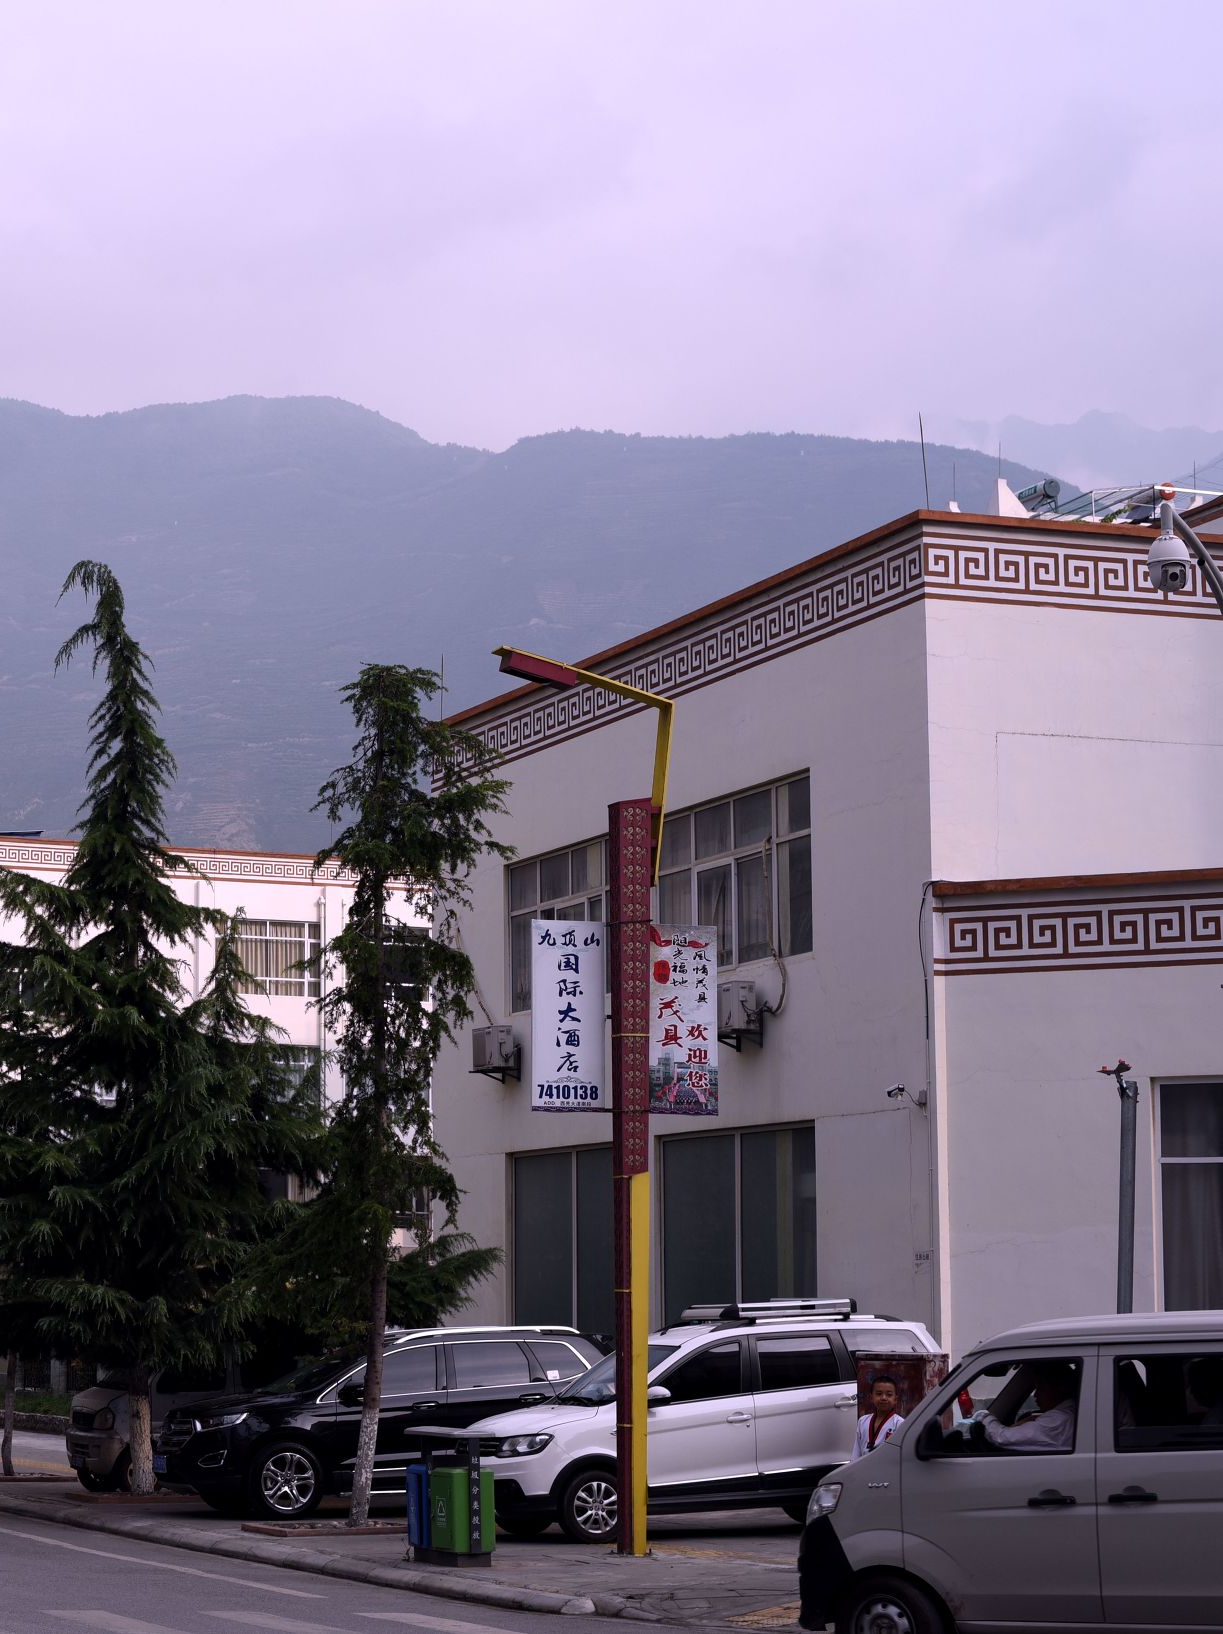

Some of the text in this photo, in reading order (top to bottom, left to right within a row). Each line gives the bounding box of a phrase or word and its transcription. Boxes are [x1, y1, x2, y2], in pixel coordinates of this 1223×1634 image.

[538, 927, 601, 949] 九顶山
[555, 953, 584, 1073] 国际大酒店
[656, 996, 684, 1048] 茂县
[685, 1024, 710, 1090] 欢迎您
[537, 1084, 599, 1100] 7410138
[471, 1456, 481, 1540] 垃圾分类投放
